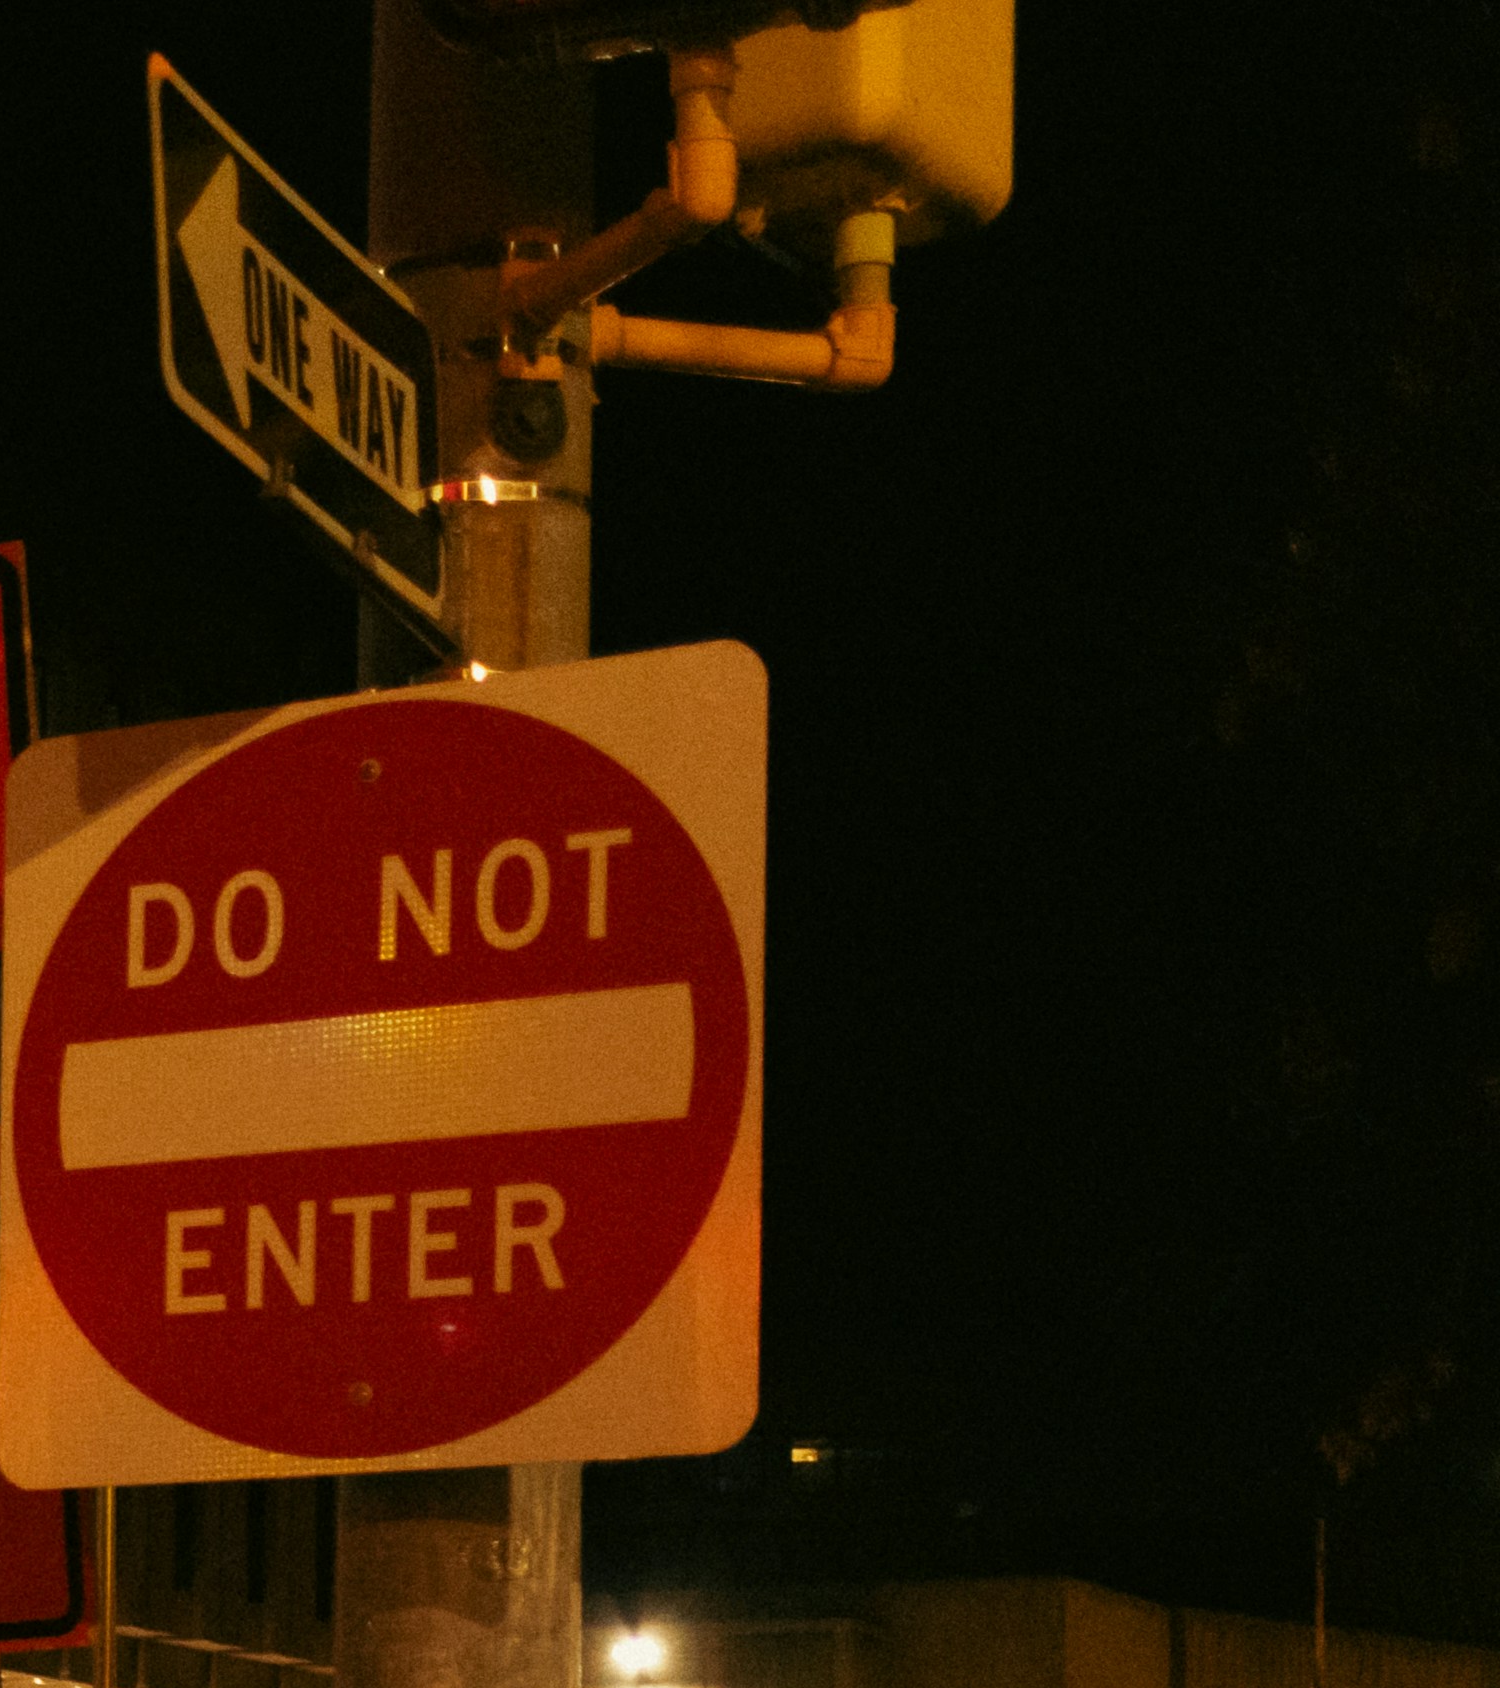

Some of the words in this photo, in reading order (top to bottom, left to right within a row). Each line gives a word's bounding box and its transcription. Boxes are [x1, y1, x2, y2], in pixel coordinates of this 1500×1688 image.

[244, 246, 315, 411] ONE
[331, 328, 406, 490] WAY
[125, 869, 286, 989] DO
[378, 828, 633, 963] NOT
[163, 1183, 567, 1316] ENTER
